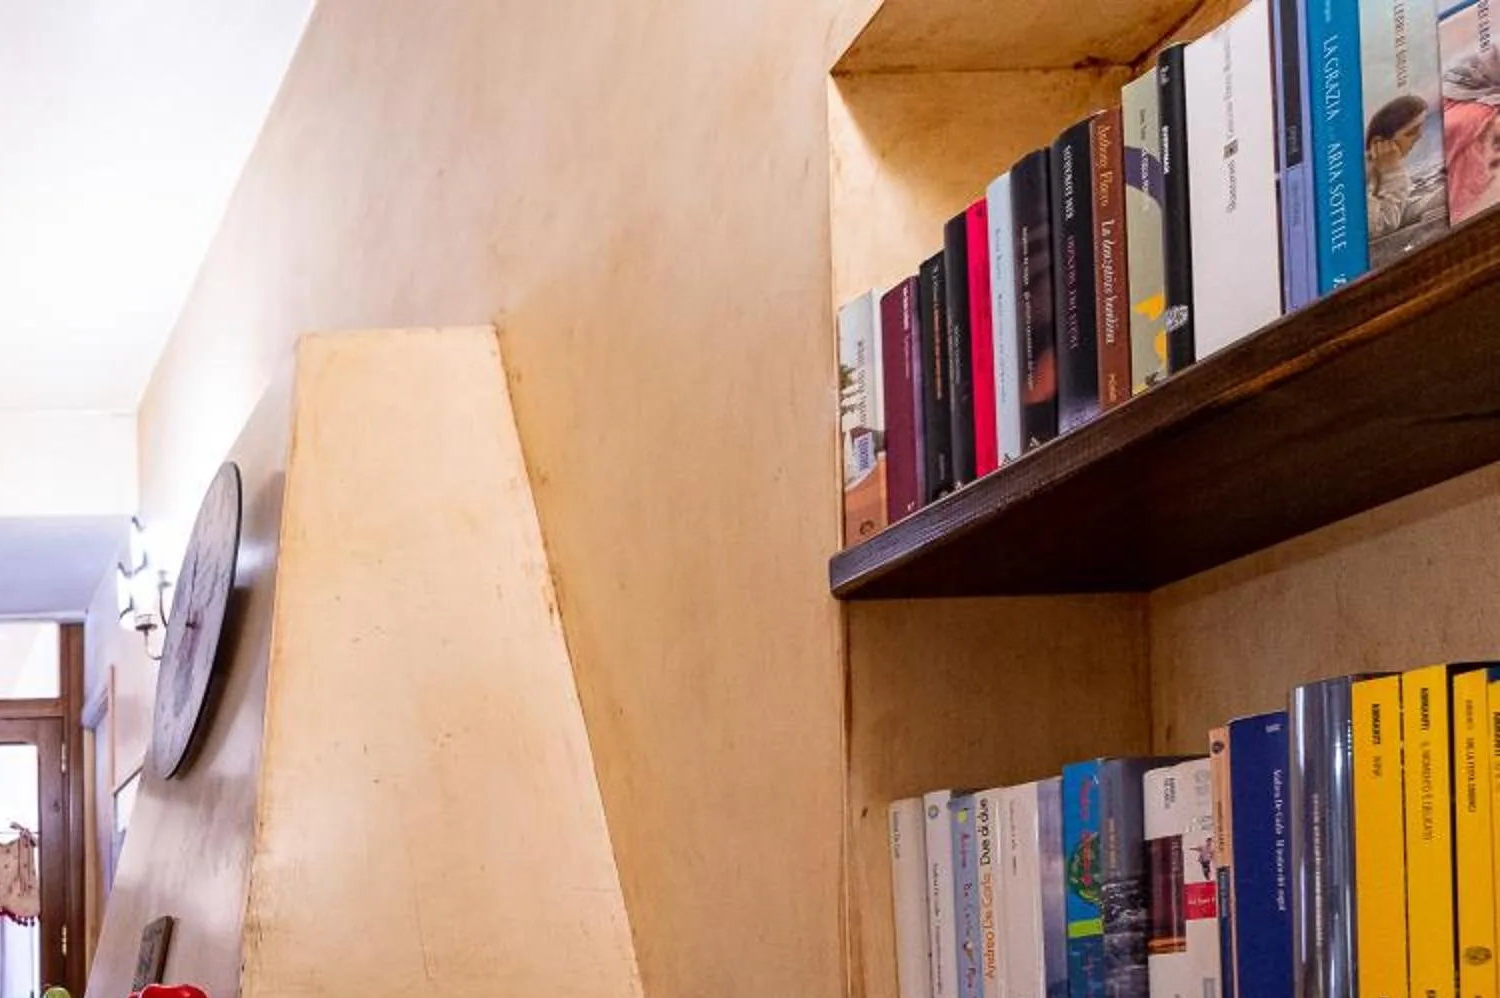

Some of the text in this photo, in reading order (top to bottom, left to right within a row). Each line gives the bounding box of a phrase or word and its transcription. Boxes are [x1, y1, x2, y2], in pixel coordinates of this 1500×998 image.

[1322, 34, 1339, 57] LA
[1323, 58, 1342, 120] GRAZIA
[1326, 141, 1347, 254] ARIA SOTTILE
[977, 798, 990, 824] due
[979, 840, 991, 866] Due
